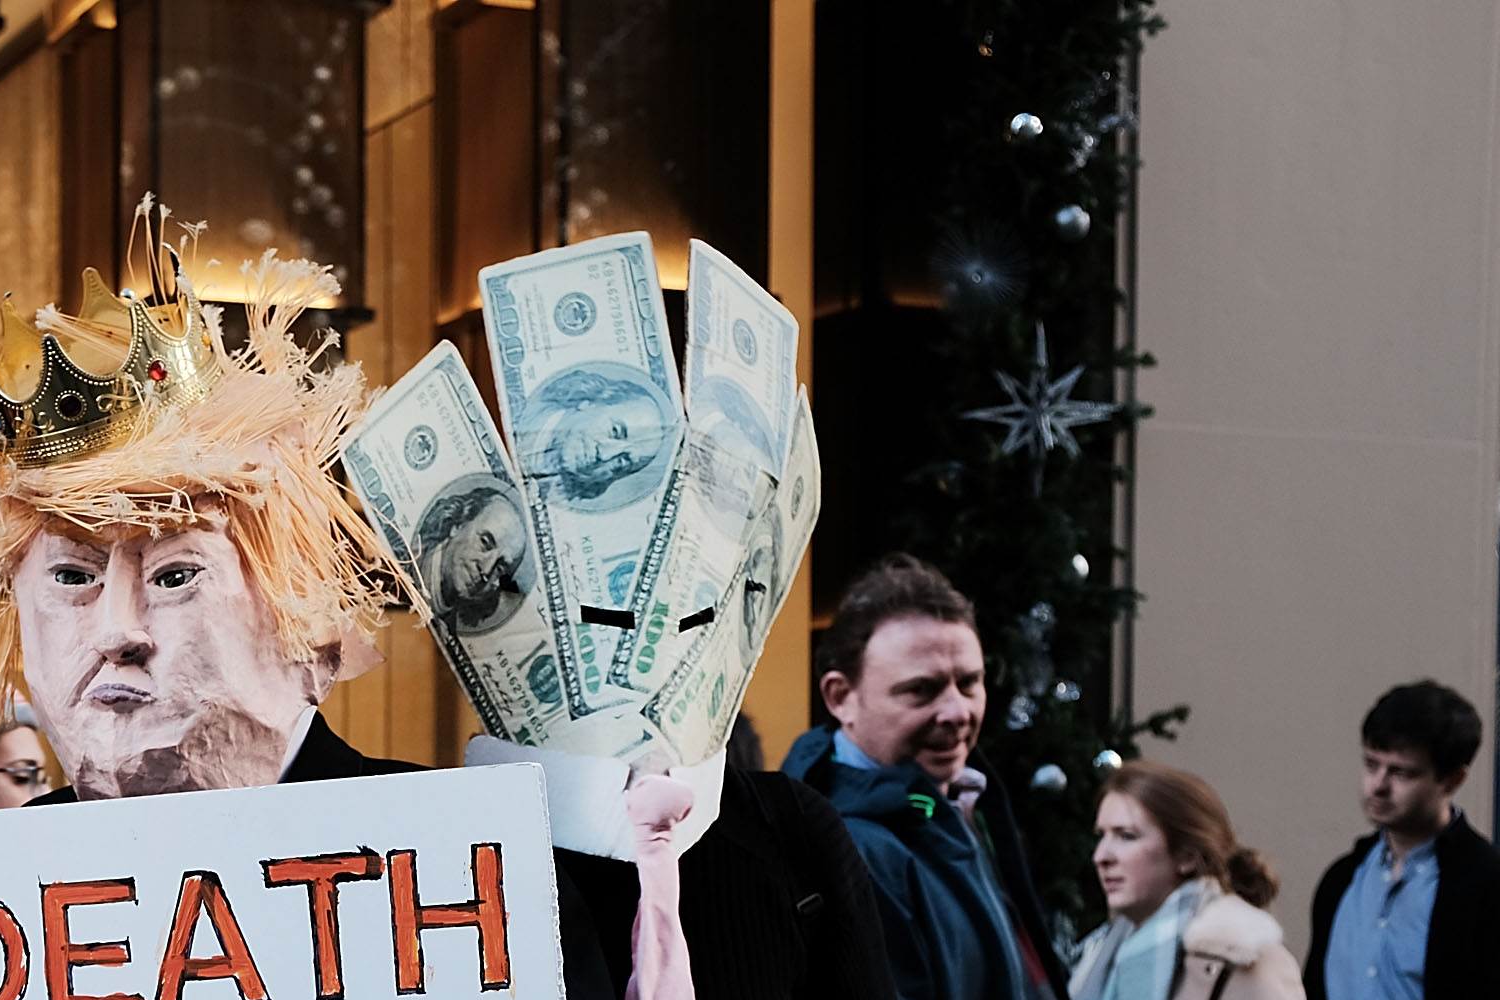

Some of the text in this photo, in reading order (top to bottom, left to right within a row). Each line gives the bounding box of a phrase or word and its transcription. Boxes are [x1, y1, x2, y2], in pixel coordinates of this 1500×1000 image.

[491, 290, 524, 367] 100
[575, 622, 601, 693] 100
[636, 600, 669, 674] 100
